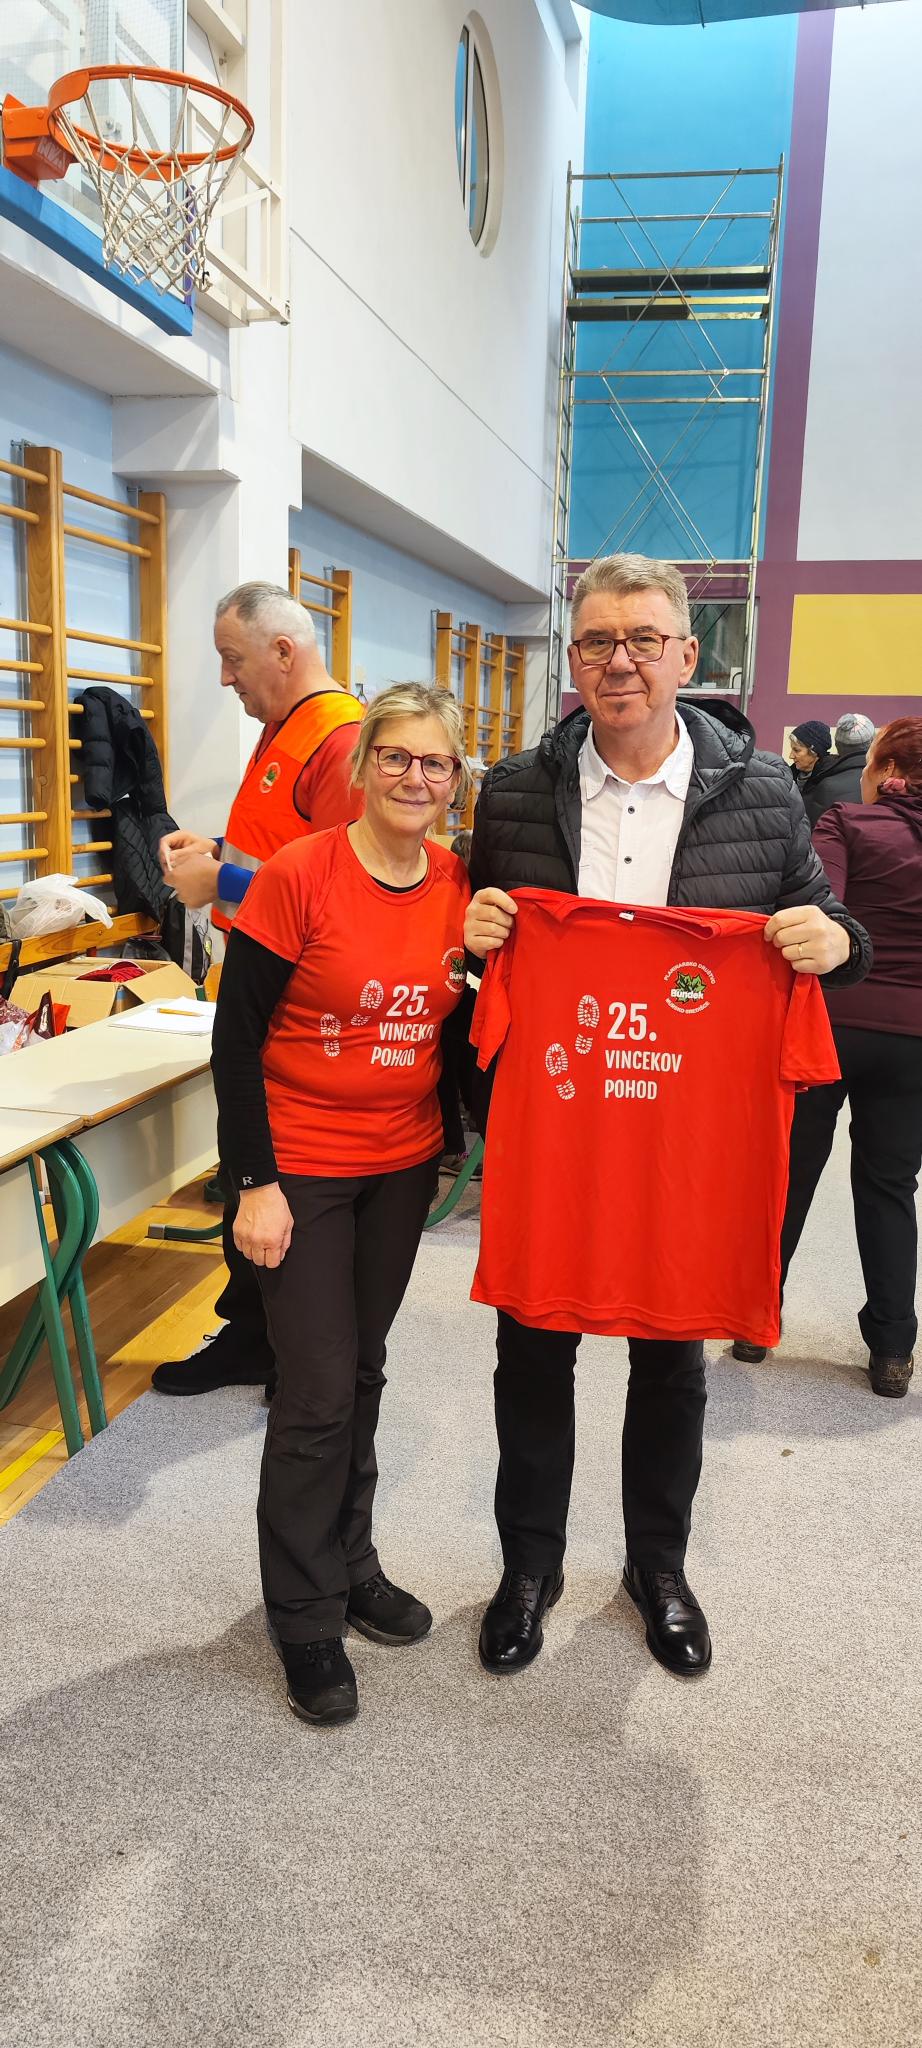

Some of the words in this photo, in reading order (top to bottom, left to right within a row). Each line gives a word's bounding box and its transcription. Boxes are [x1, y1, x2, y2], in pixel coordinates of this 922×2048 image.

[385, 984, 430, 1017] 25.
[607, 1001, 657, 1042] 25.
[370, 1045, 416, 1067] POHOD
[604, 1049, 683, 1073] VINCEKOV
[604, 1078, 658, 1100] POHOD
[242, 1176, 254, 1186] R
